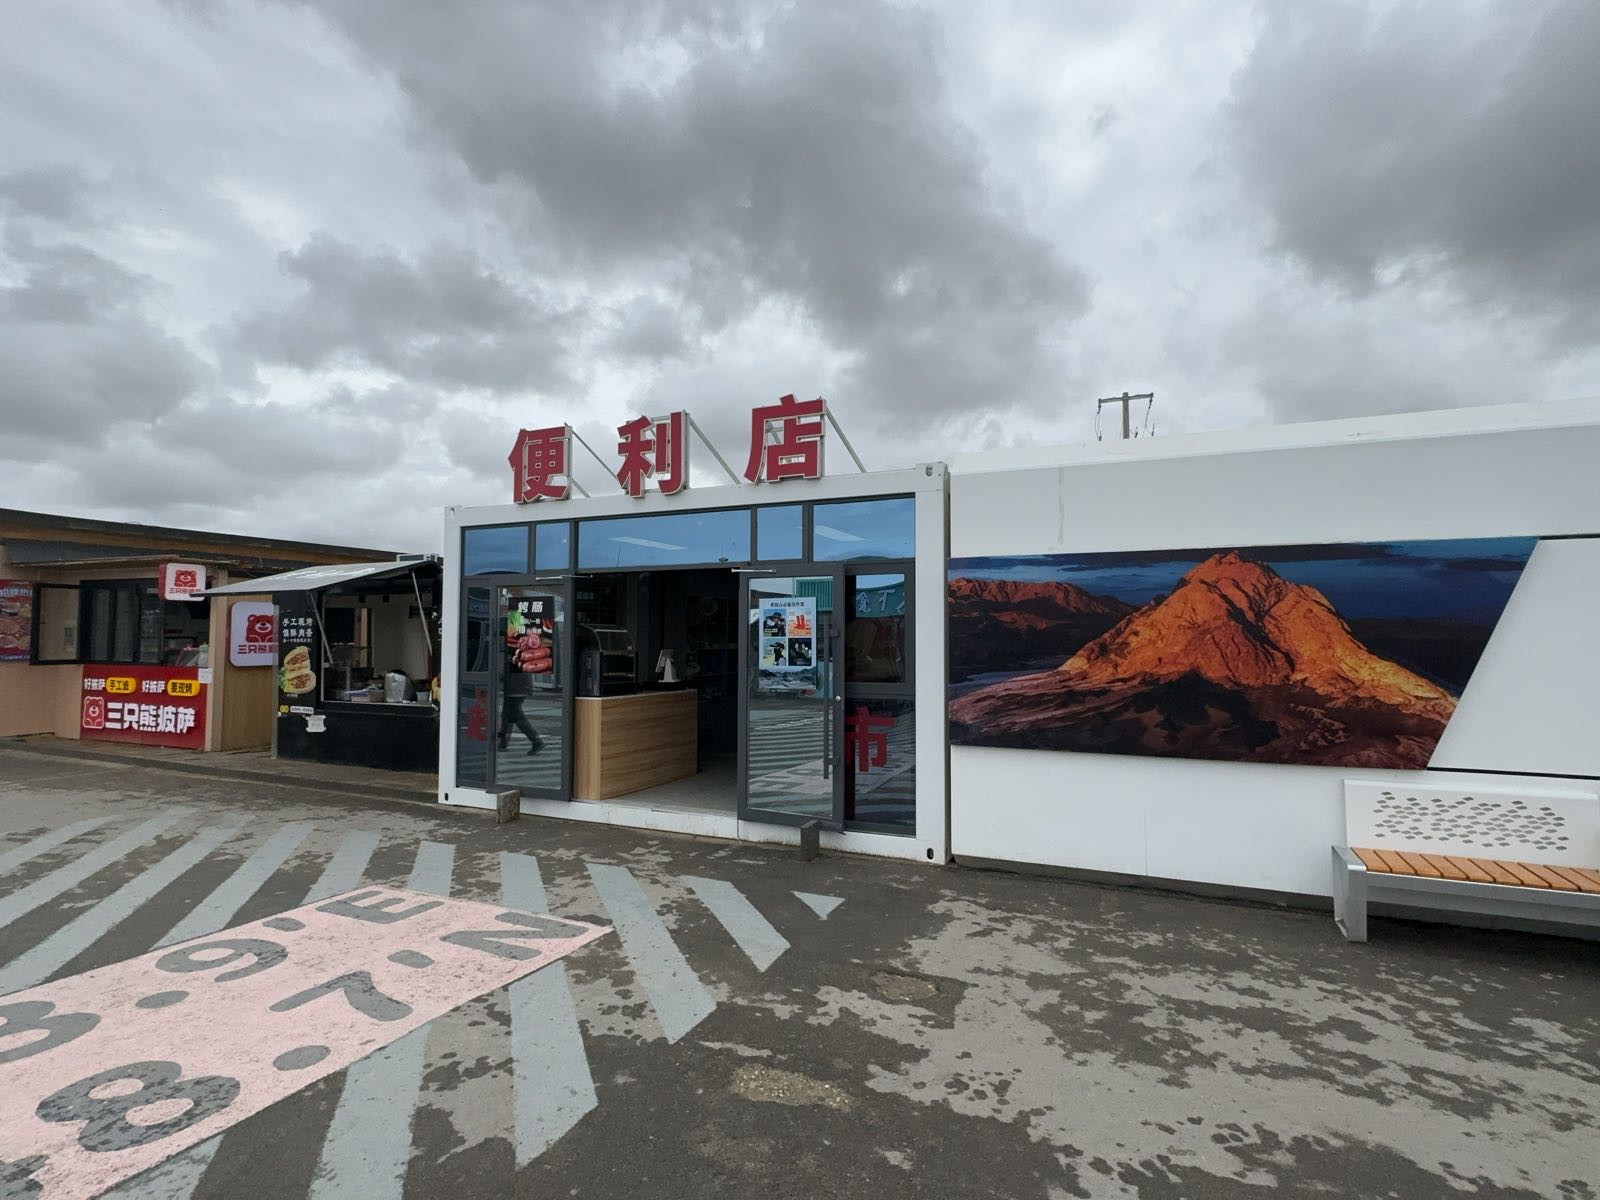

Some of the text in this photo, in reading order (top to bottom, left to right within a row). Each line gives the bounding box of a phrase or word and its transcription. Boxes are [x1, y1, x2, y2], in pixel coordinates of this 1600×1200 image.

[508, 394, 824, 504] 便利店
[104, 702, 195, 734] 三只熊披萨
[844, 706, 897, 773] 市
